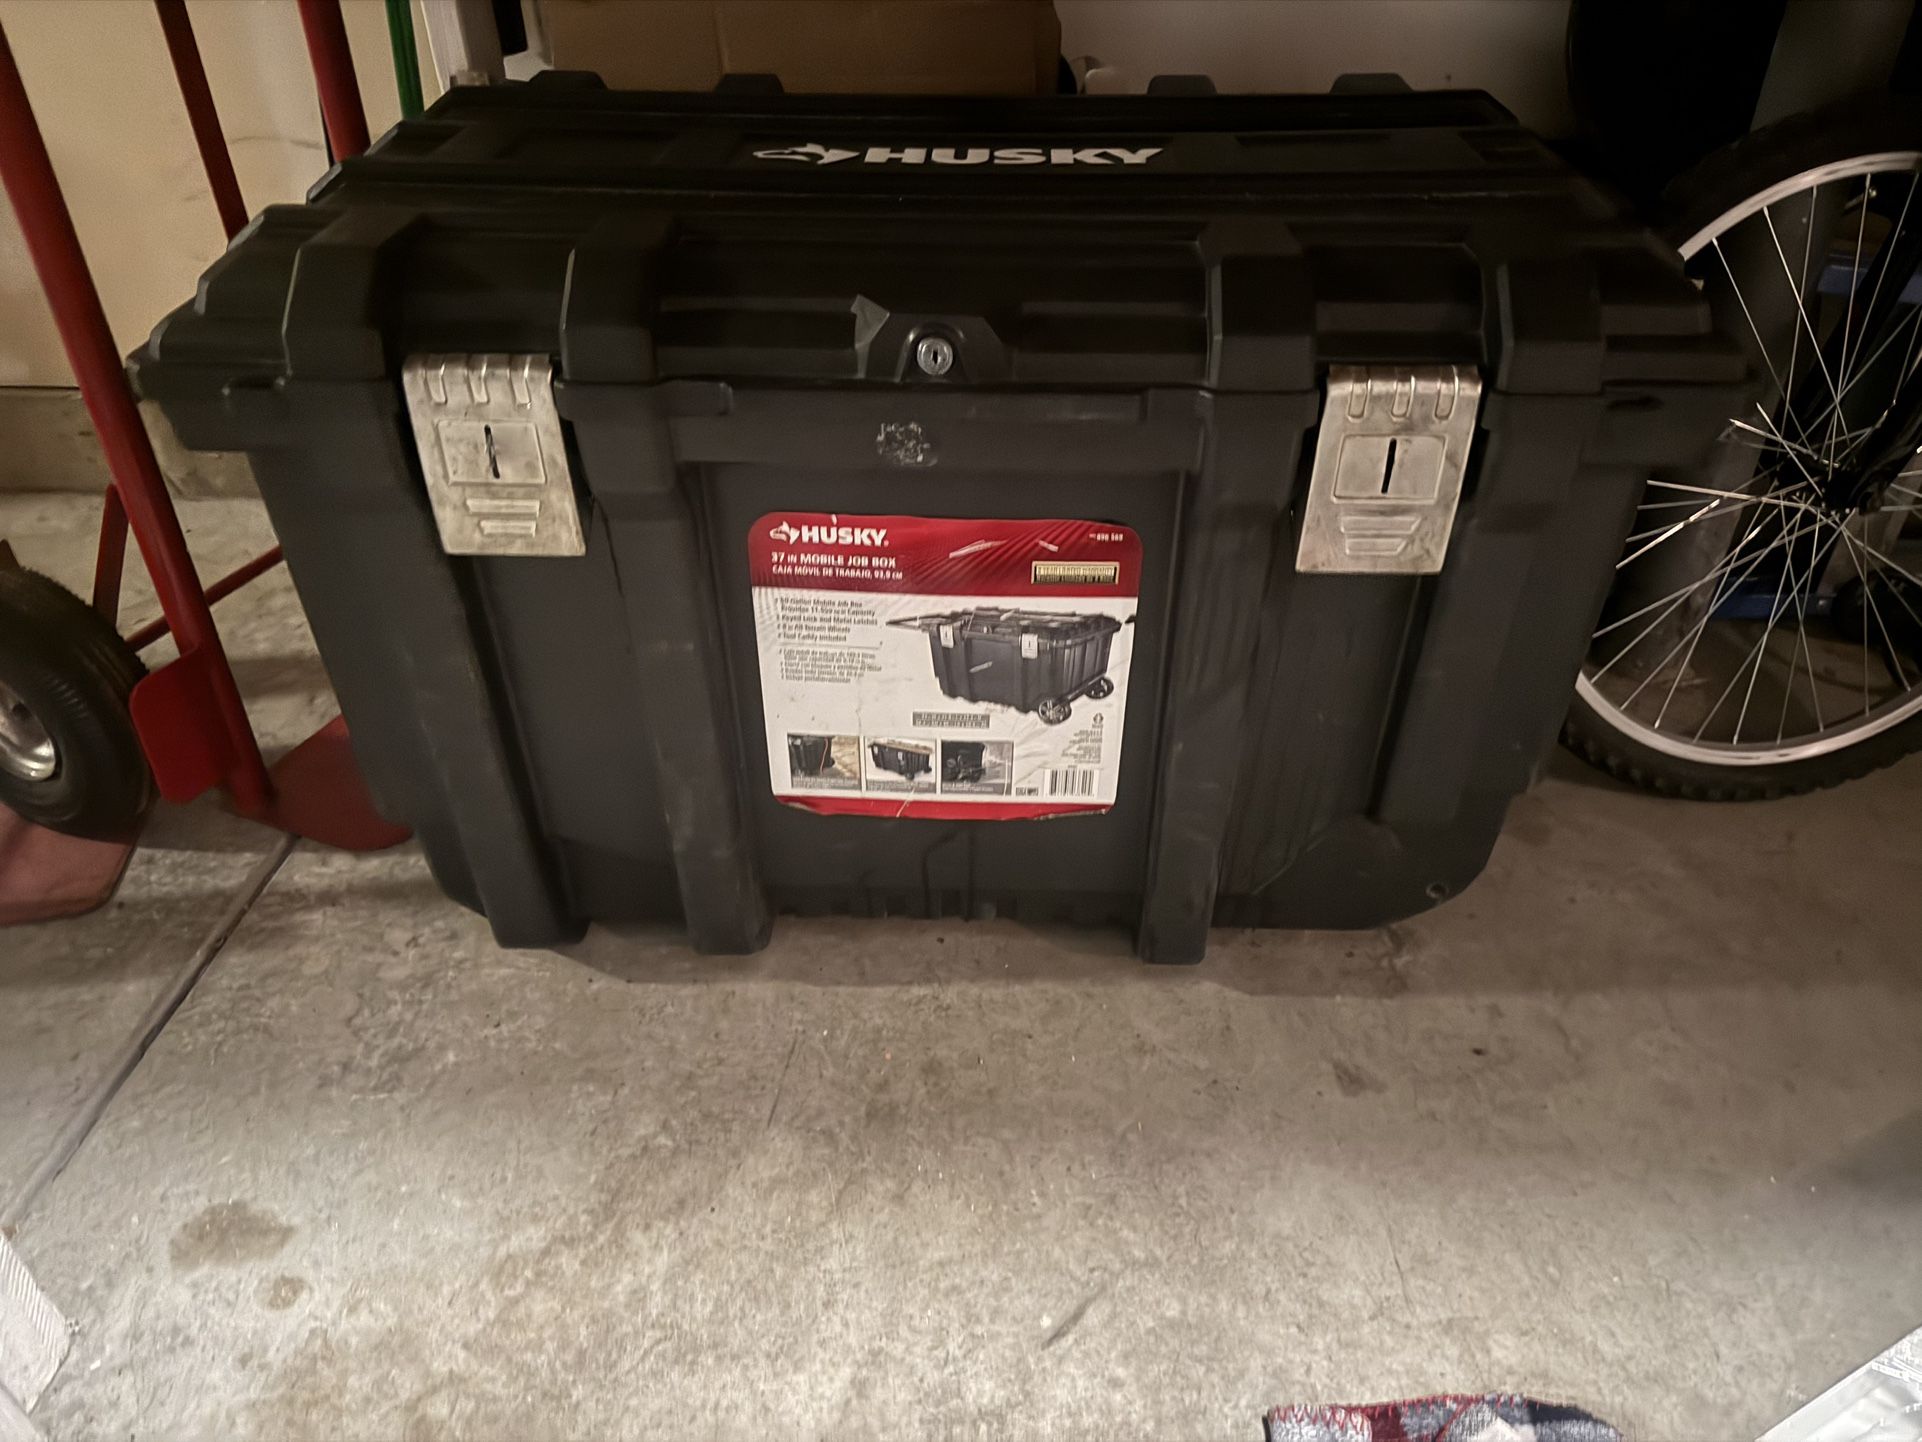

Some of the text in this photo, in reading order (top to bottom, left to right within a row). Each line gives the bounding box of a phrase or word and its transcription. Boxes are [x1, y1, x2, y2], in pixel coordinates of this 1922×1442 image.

[863, 147, 1163, 164] HUSKY
[801, 525, 888, 547] HUSKY
[771, 552, 896, 568] 37 IN MOBILE JOB BOX
[772, 564, 792, 575] CAJA
[822, 566, 833, 577] DE
[813, 599, 835, 607] Mobile
[848, 608, 875, 617] Capacity
[828, 625, 850, 633] Wheels
[798, 632, 818, 642] Caddy
